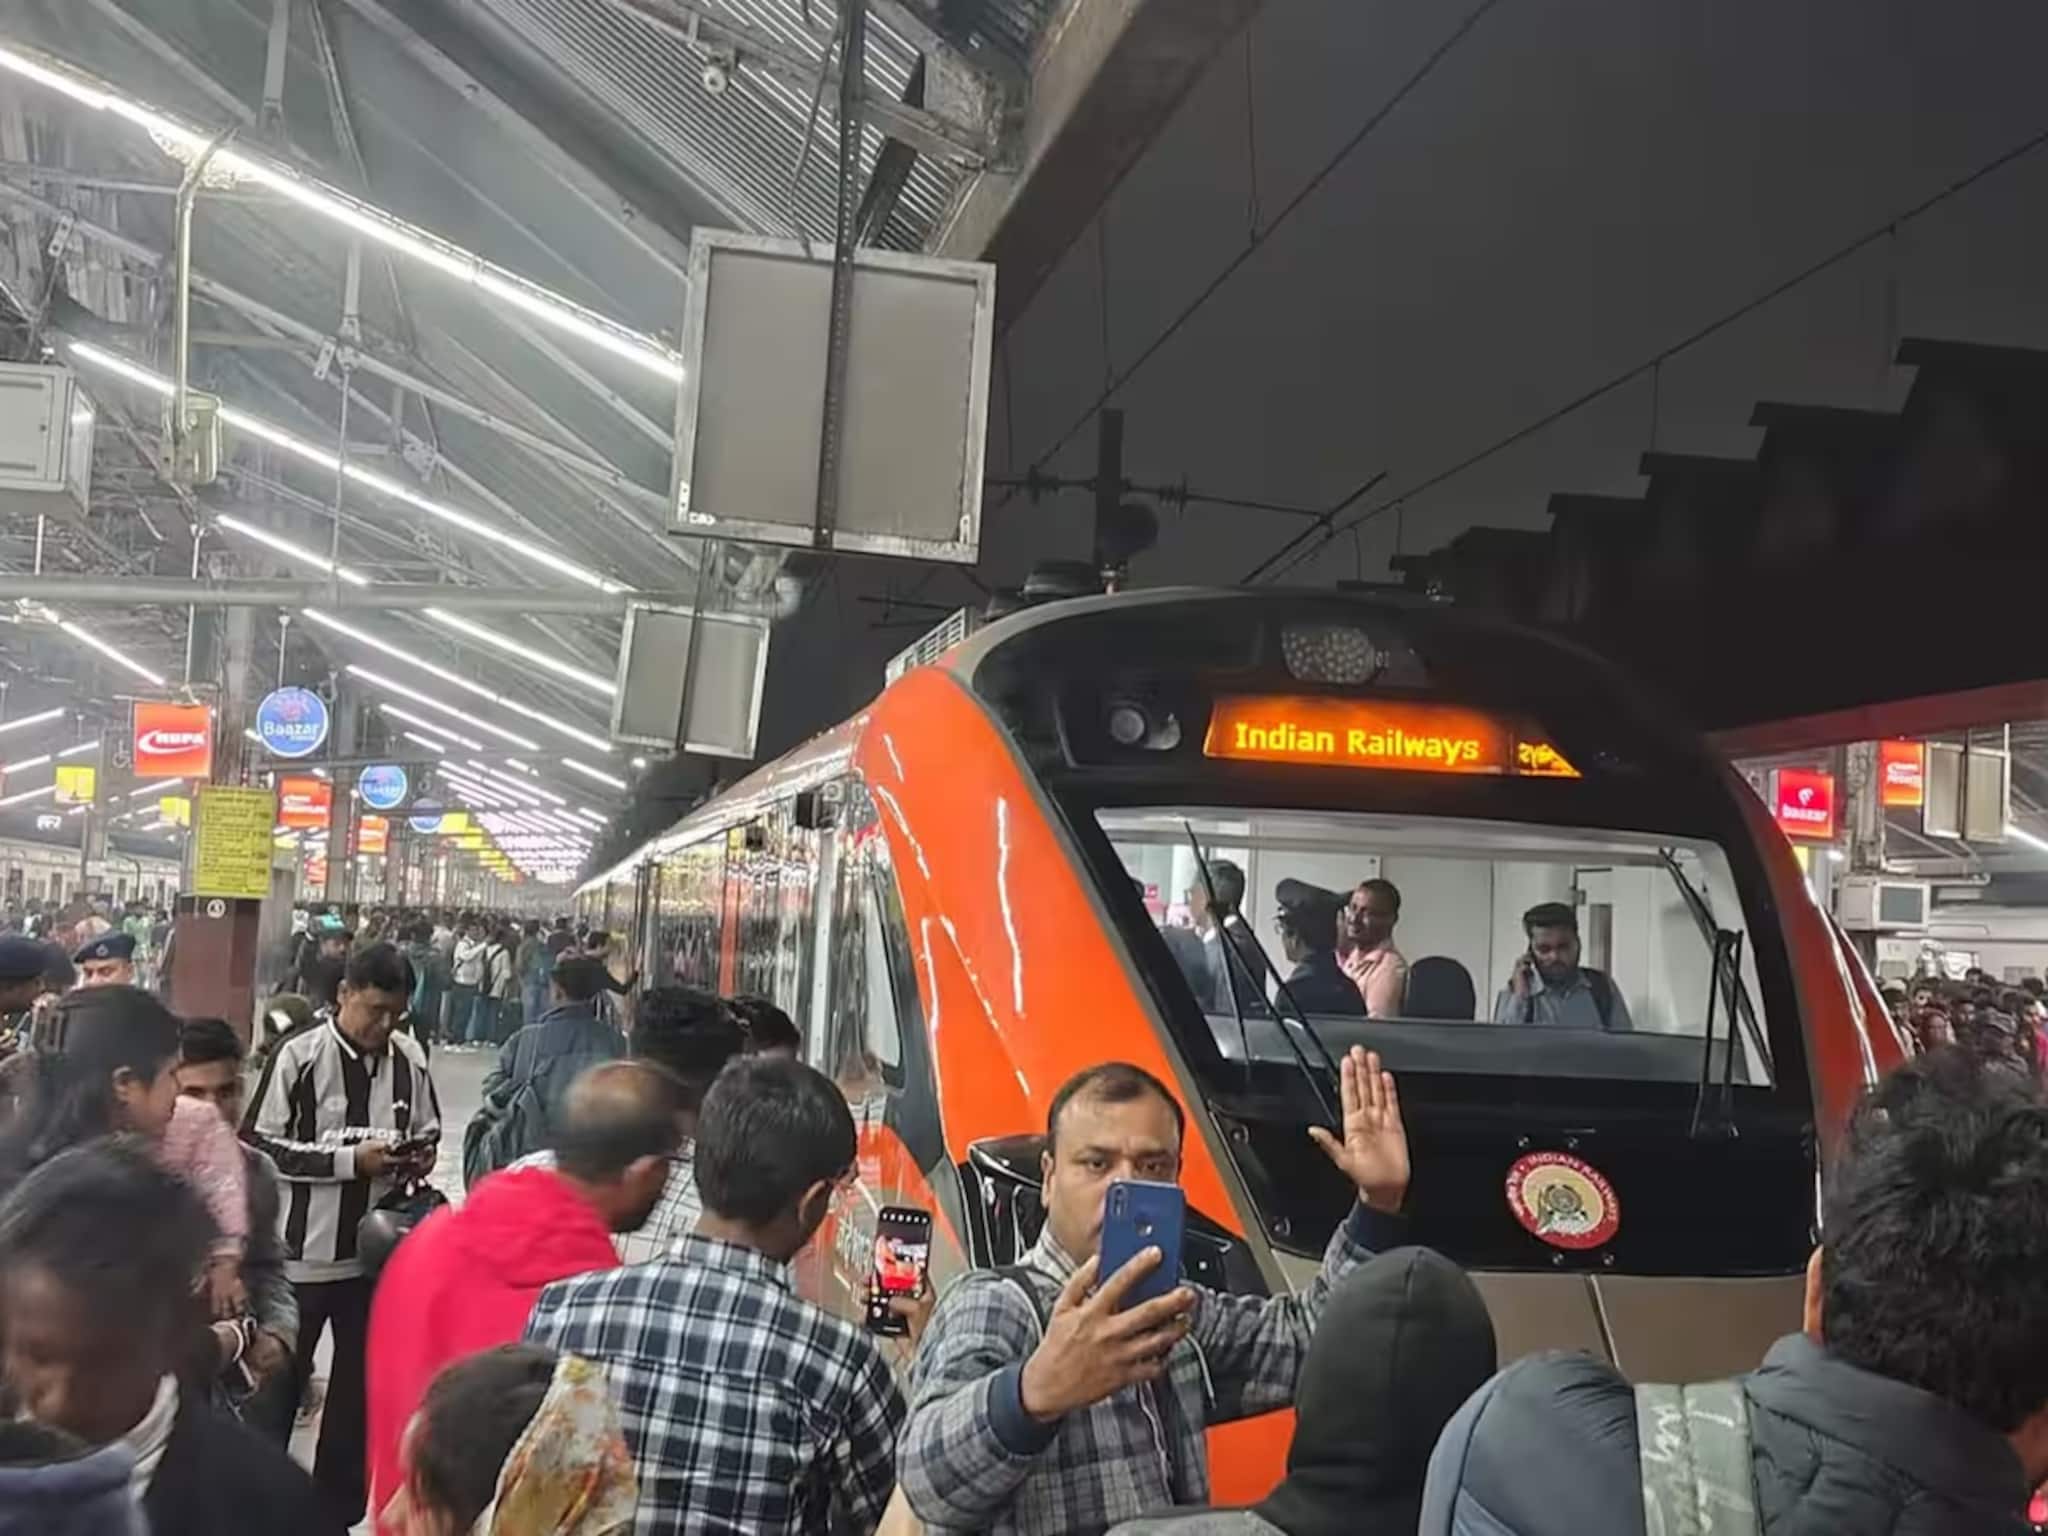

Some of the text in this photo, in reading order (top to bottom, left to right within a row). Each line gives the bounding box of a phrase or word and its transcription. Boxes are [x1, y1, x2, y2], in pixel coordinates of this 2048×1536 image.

[1235, 722, 1335, 752] Indian
[1347, 728, 1480, 765] Railways
[1528, 1152, 1580, 1169] INDIAN
